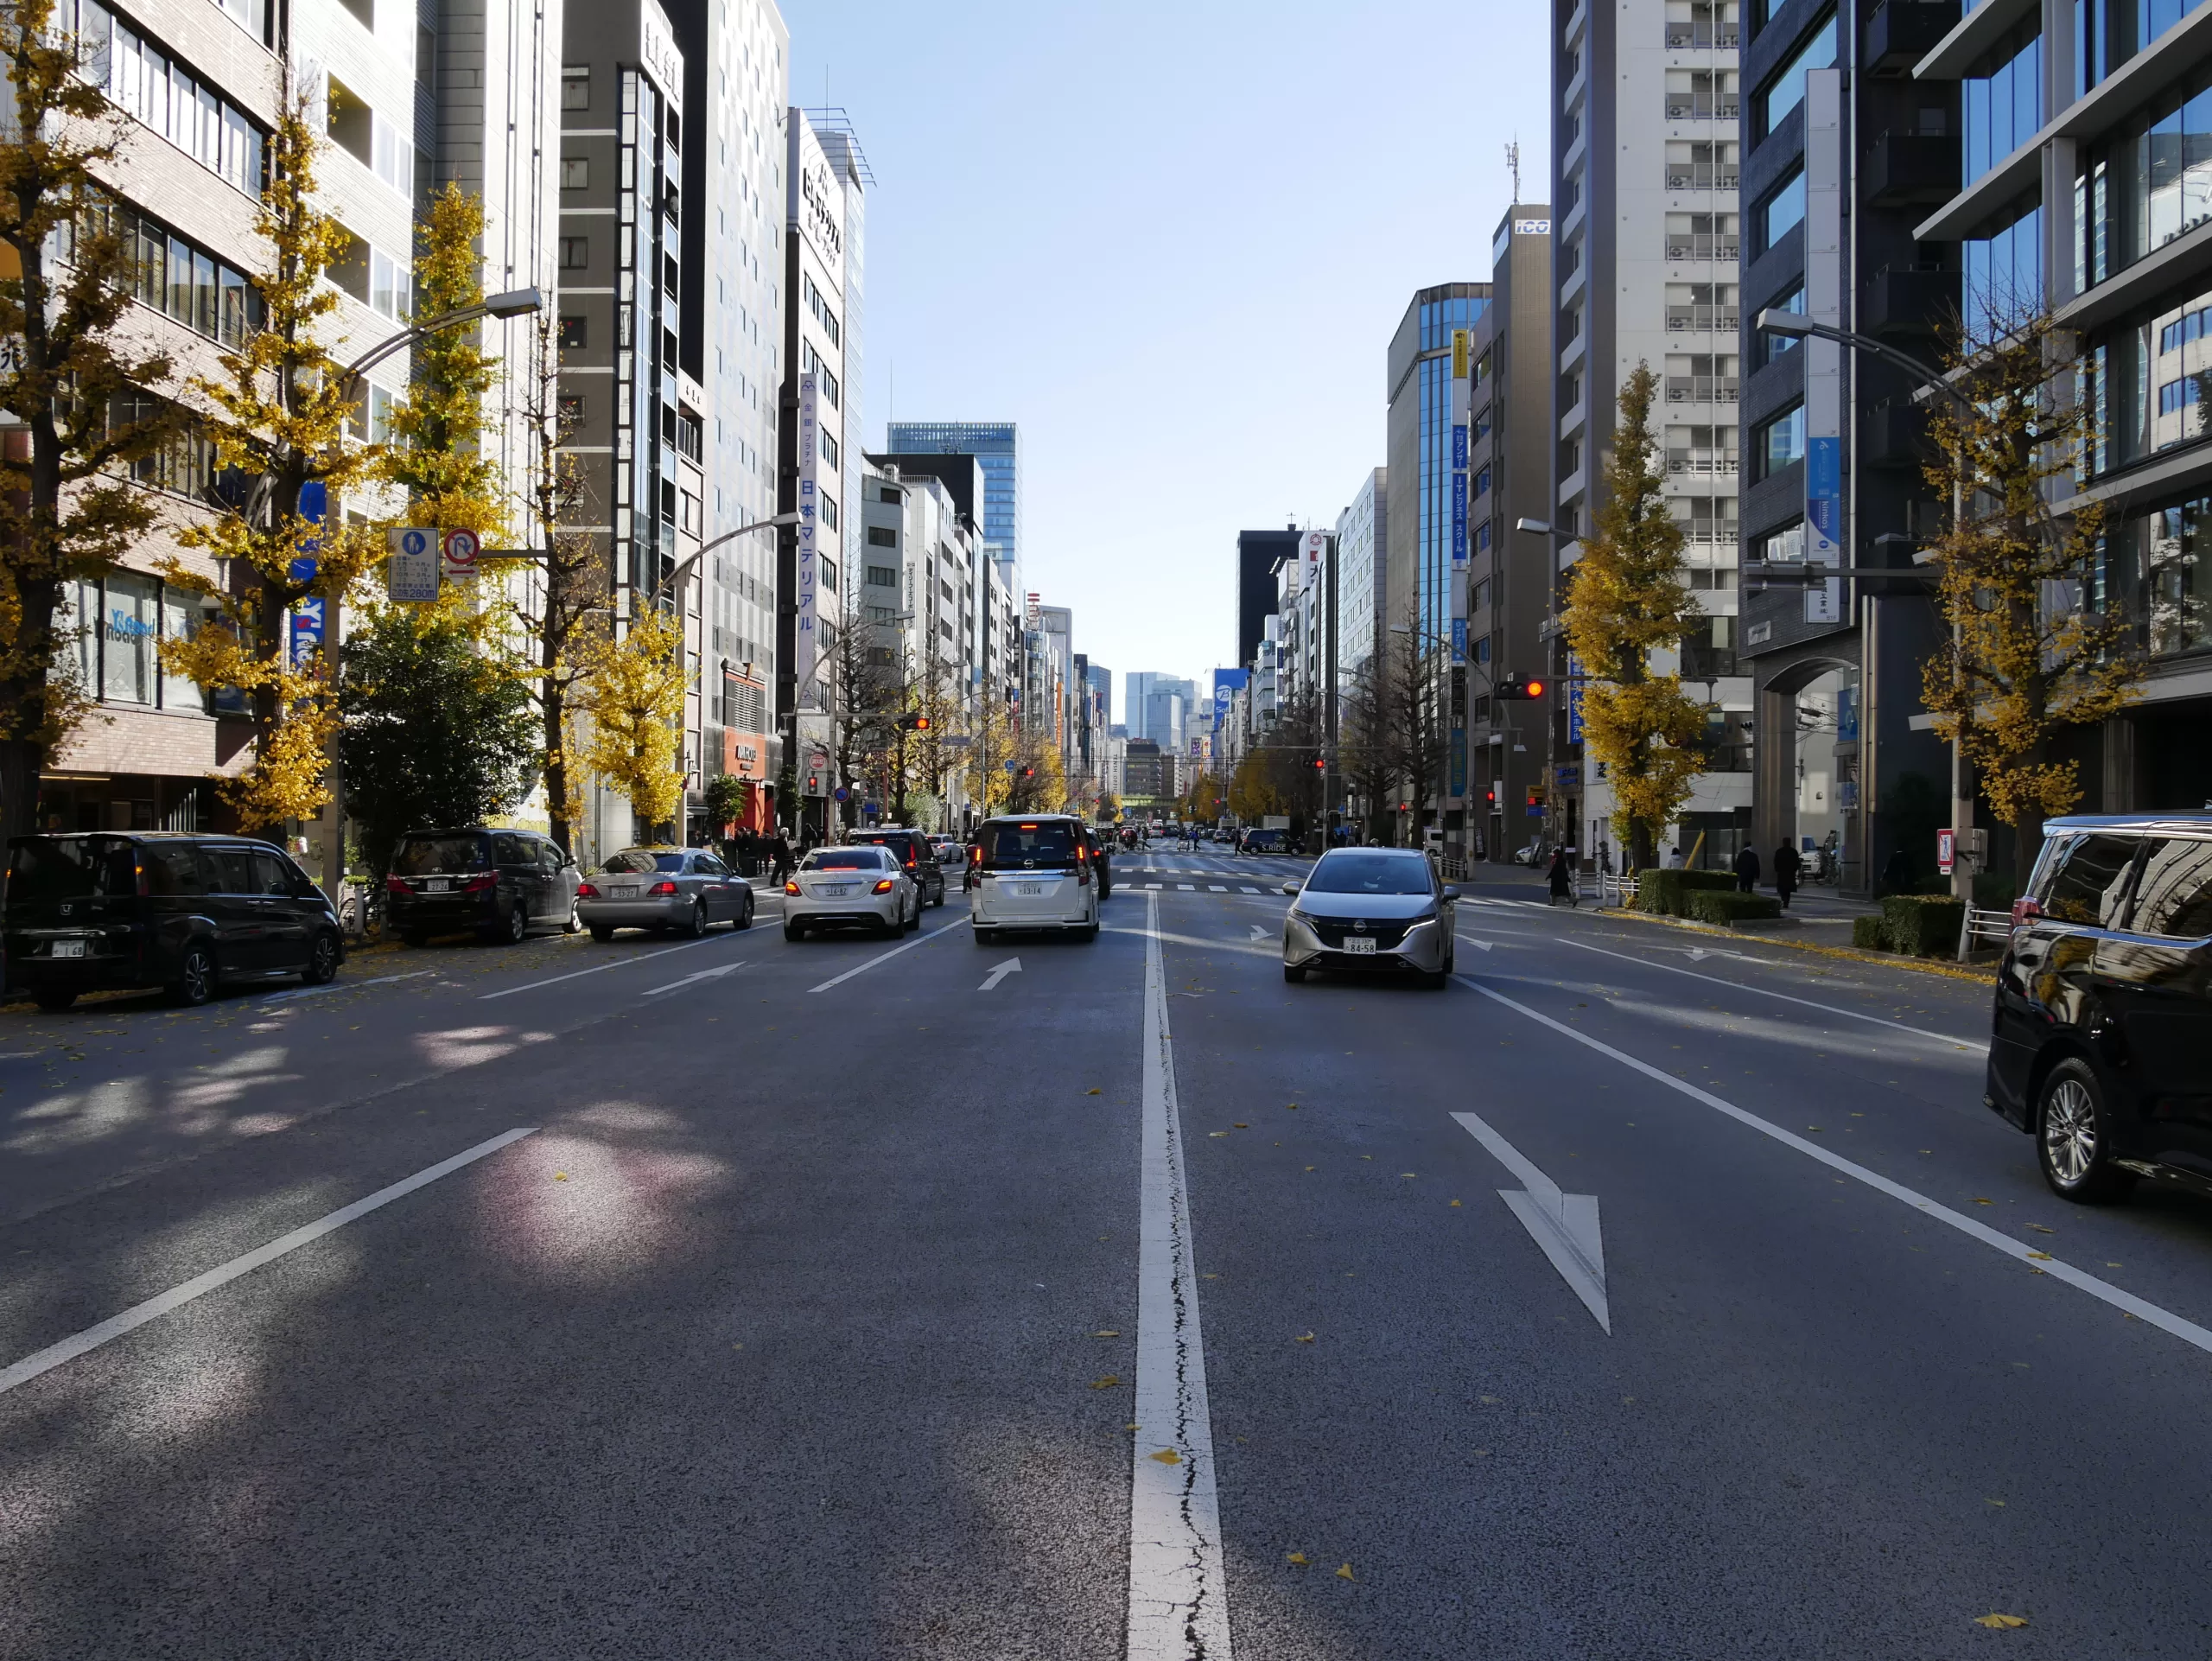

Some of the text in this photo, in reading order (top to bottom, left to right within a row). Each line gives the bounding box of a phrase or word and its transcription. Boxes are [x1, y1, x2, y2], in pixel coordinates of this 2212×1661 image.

[804, 403, 812, 412] 金
[804, 418, 812, 427] 銀
[801, 480, 815, 631] 日本マテリアル
[1351, 944, 1375, 953] 84-58
